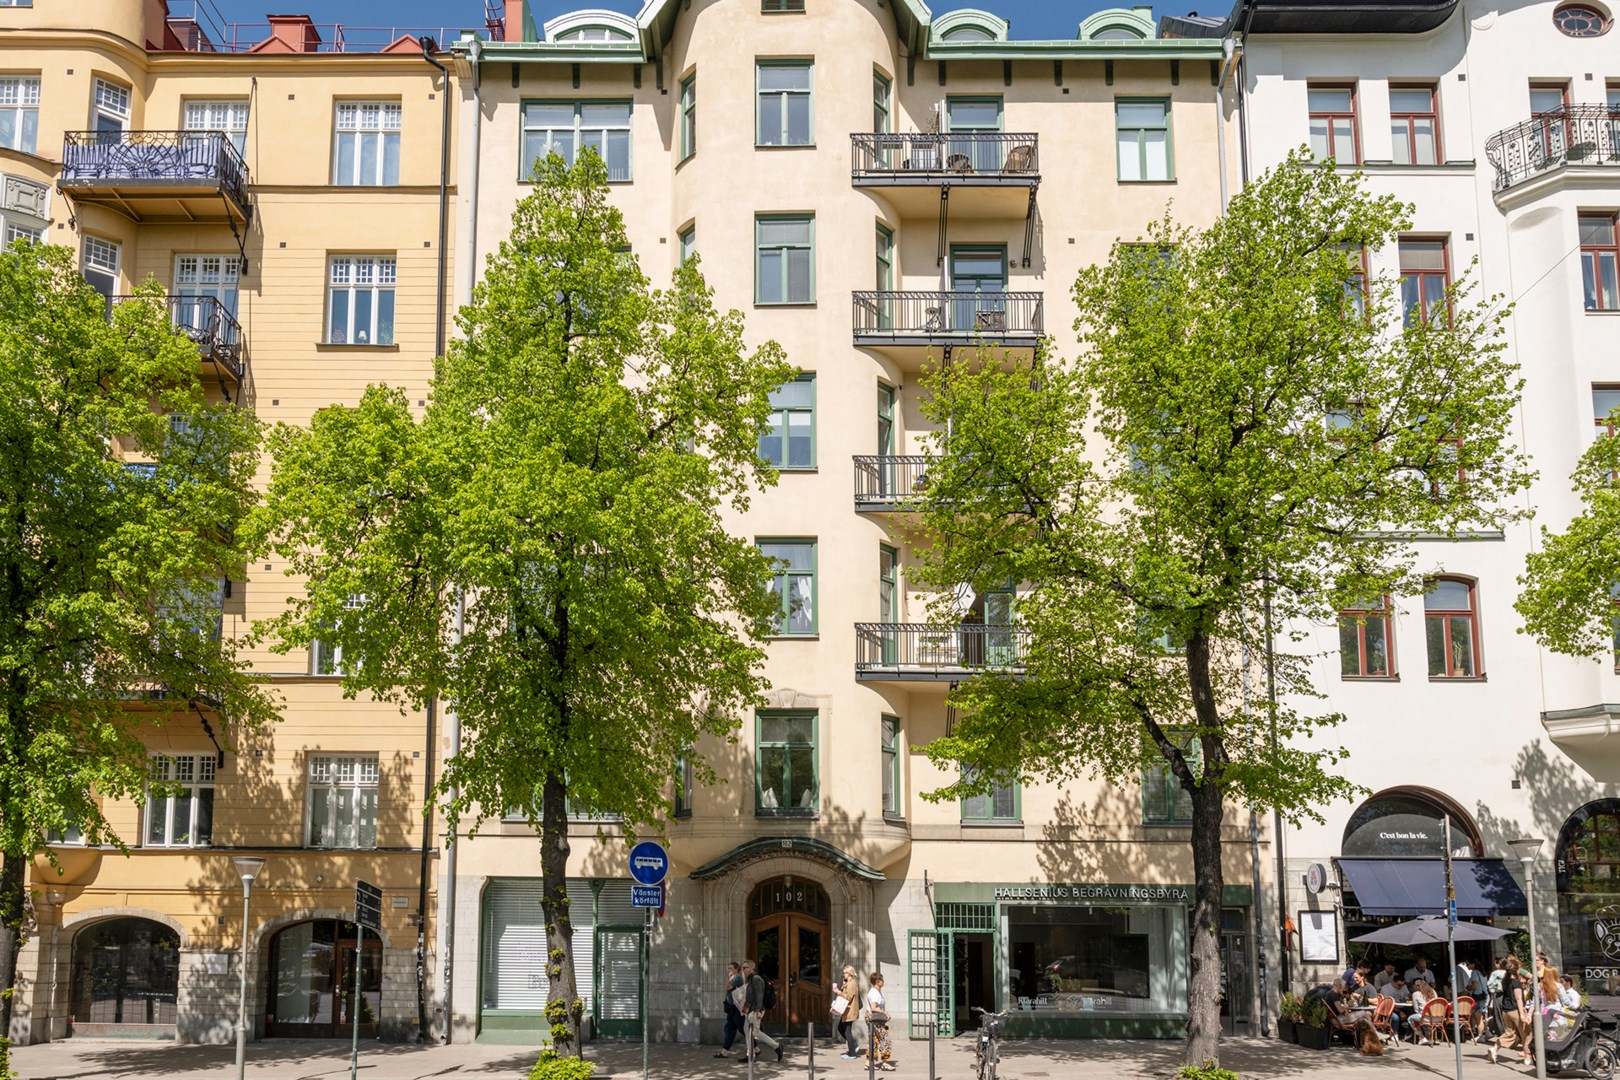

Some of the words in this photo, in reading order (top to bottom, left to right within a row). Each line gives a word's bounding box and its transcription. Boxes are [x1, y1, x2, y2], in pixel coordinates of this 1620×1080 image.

[633, 888, 661, 896] Vänster
[776, 891, 803, 902] 102
[994, 887, 1068, 898] HALLSENIUS
[634, 896, 659, 904] körfält
[1585, 968, 1610, 979] DOG
